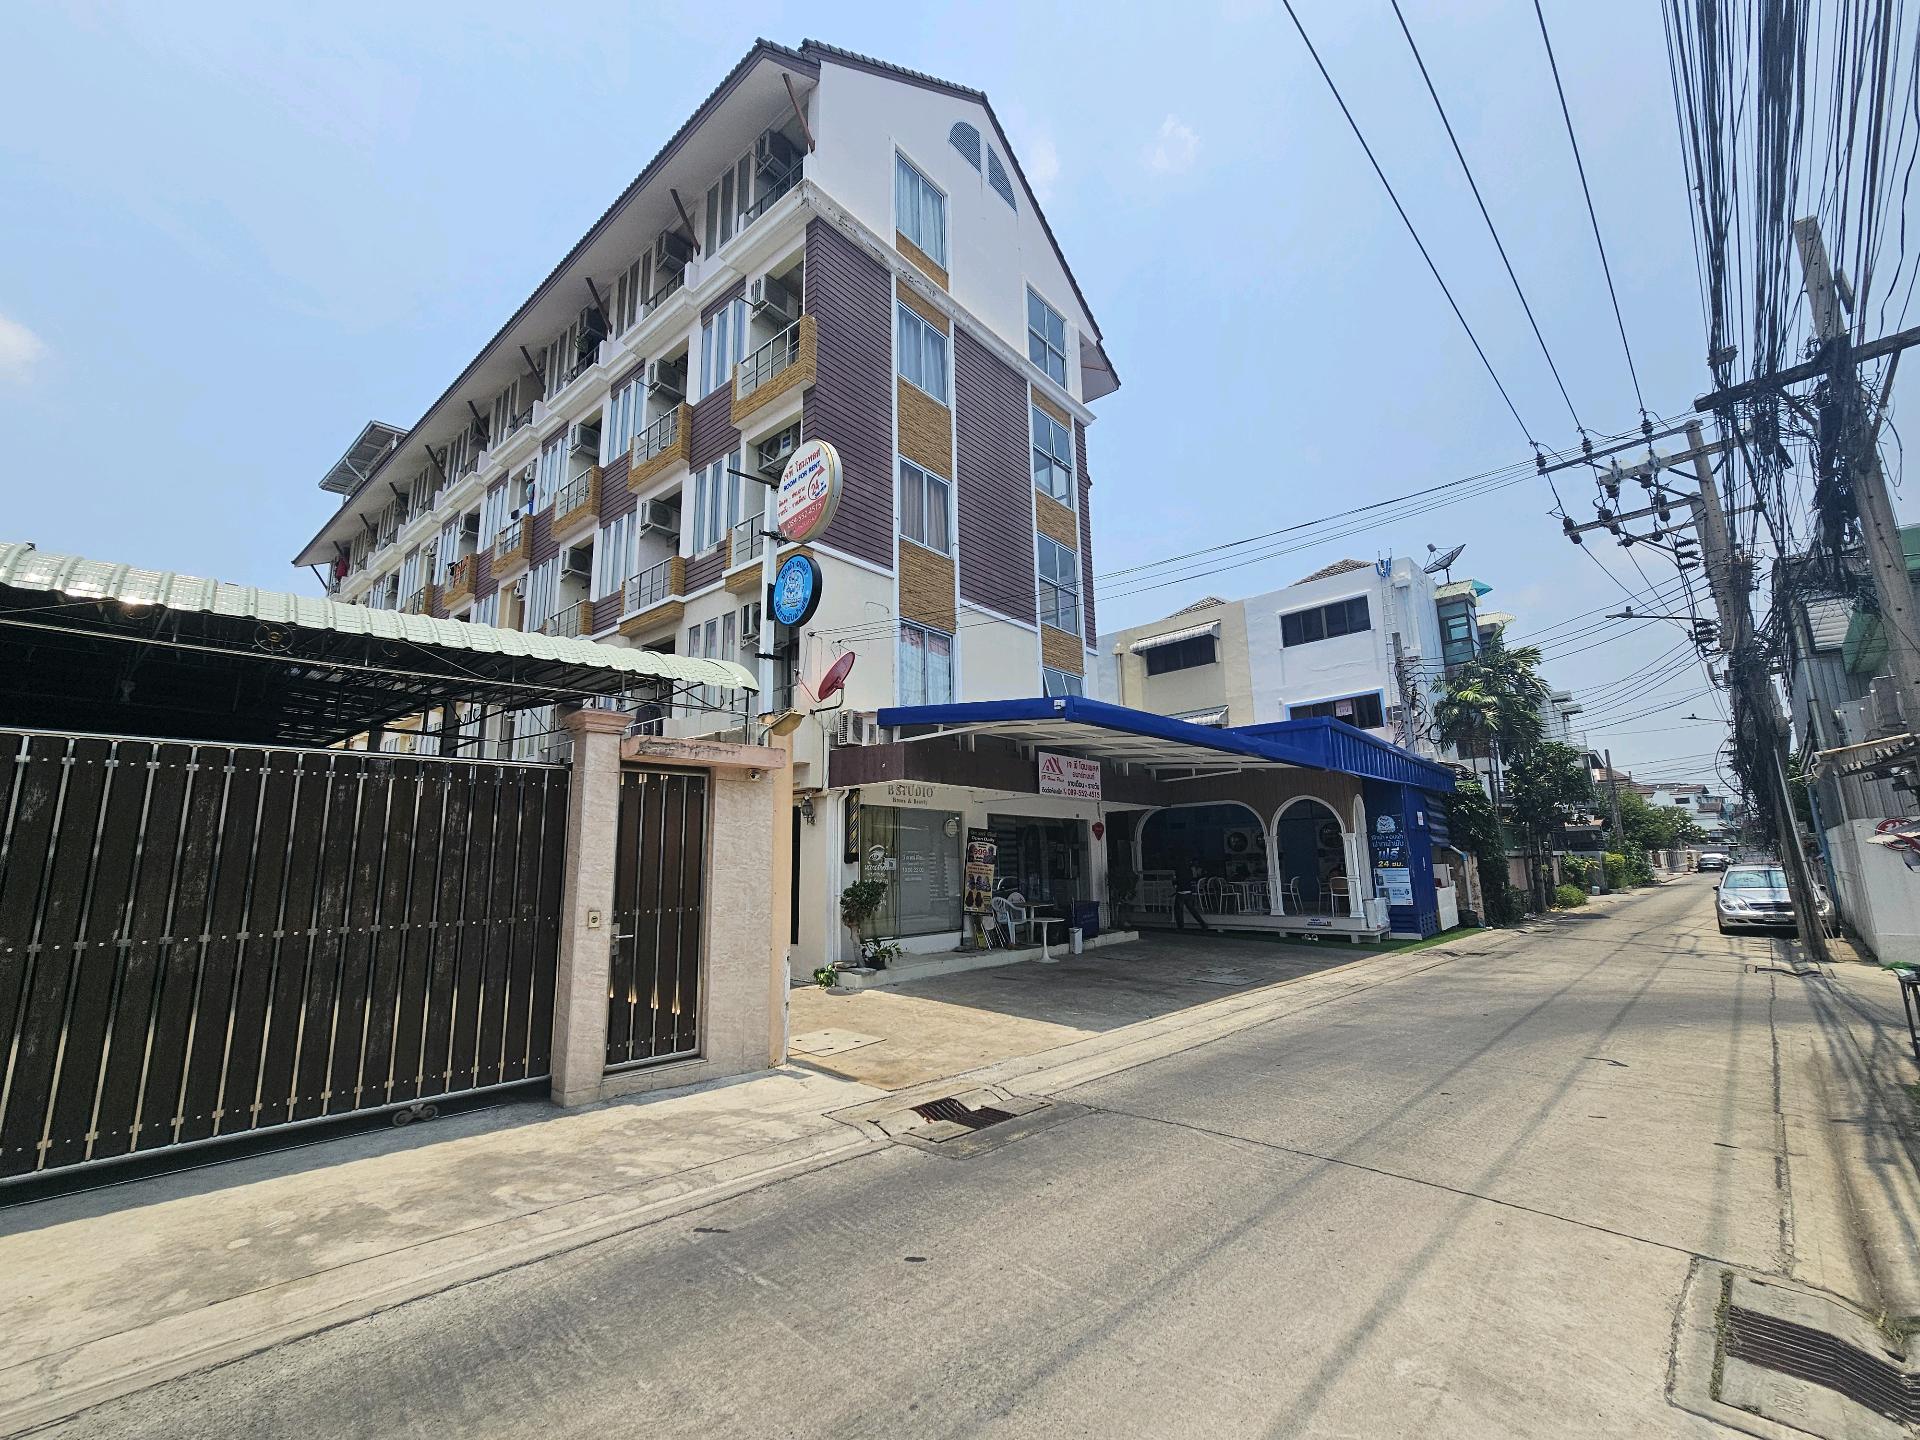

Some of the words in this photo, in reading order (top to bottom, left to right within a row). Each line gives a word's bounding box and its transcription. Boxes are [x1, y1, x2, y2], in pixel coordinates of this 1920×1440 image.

[783, 478, 797, 492] ROOM
[798, 470, 808, 481] FOR
[808, 460, 821, 474] RENT
[811, 479, 820, 496] 24
[1378, 846, 1400, 860] ฟรี
